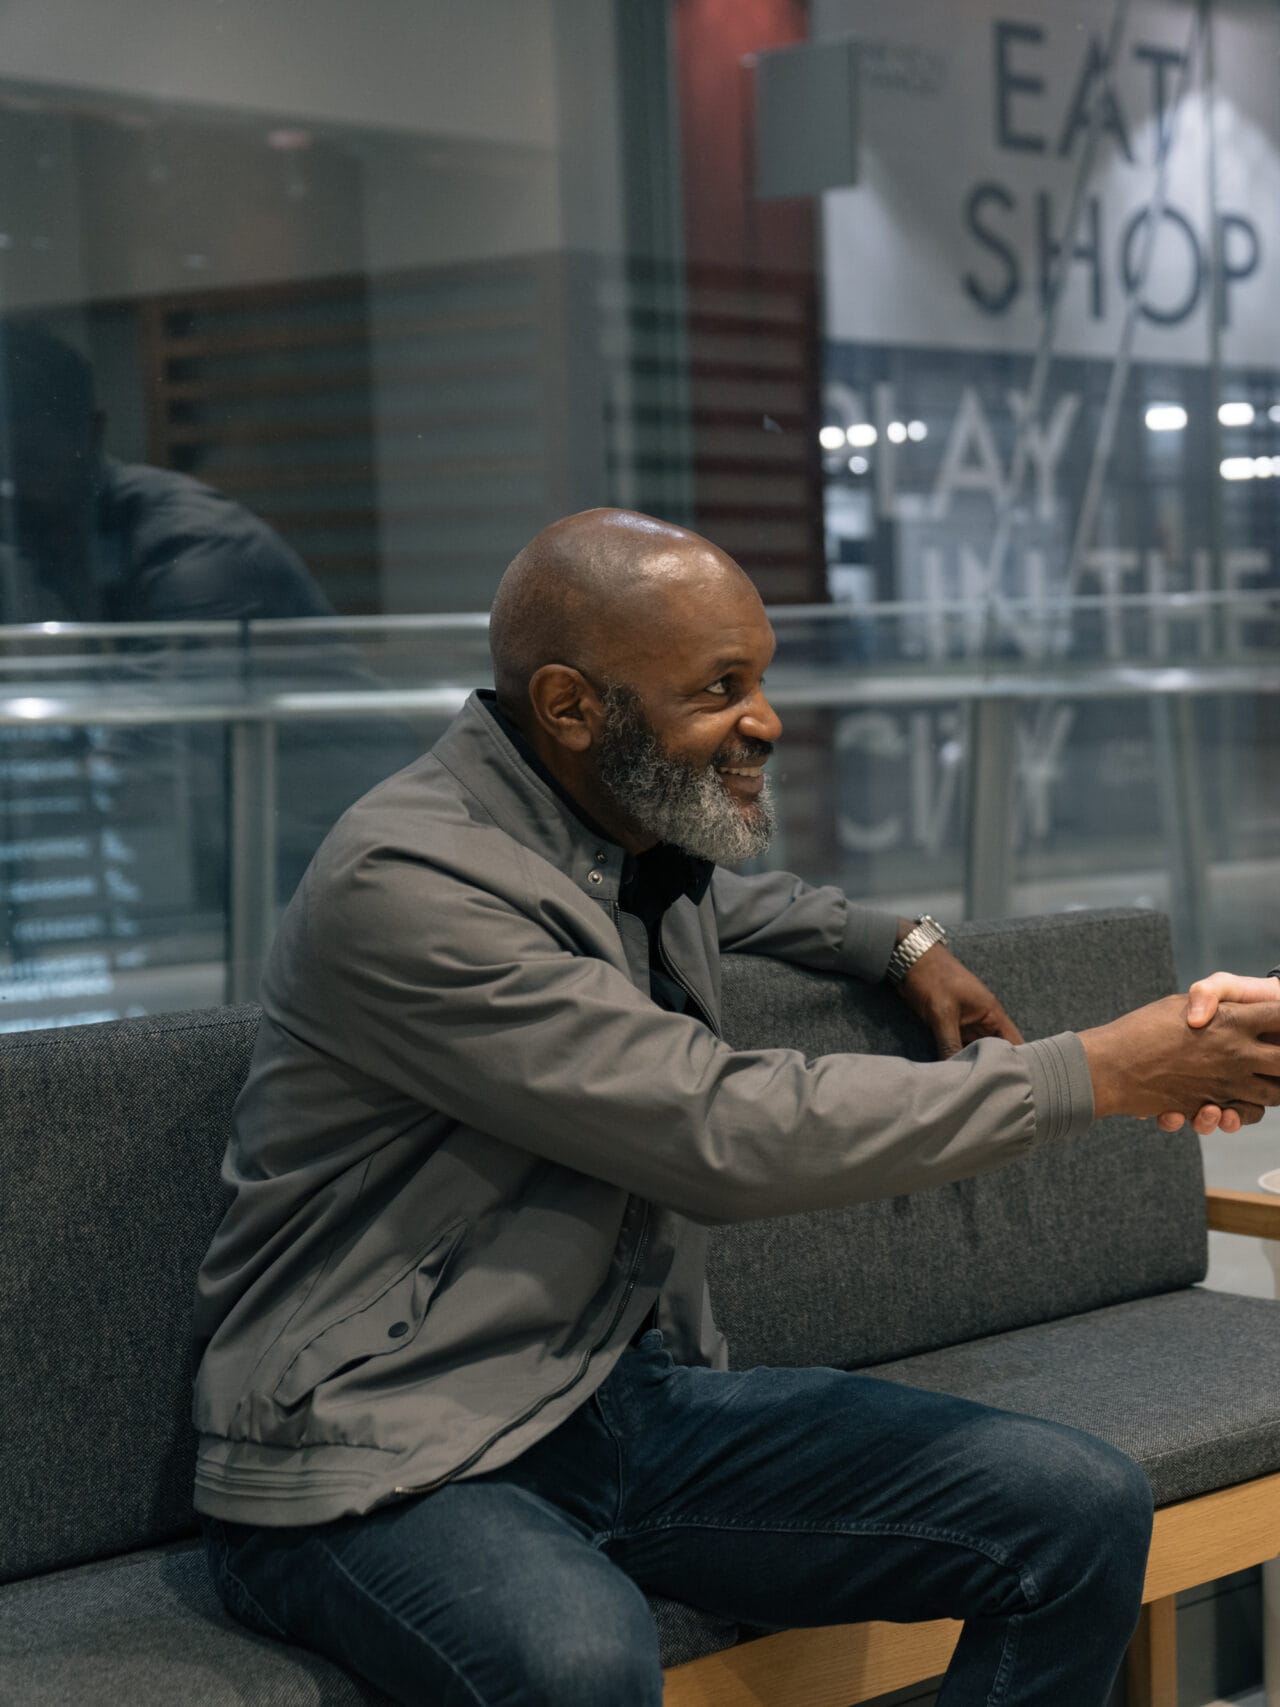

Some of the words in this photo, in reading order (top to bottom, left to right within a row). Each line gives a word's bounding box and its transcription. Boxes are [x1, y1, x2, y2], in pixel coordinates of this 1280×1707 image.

[992, 20, 1188, 166] EAT
[962, 182, 1262, 331] SHOP
[834, 705, 1075, 852] CIY
